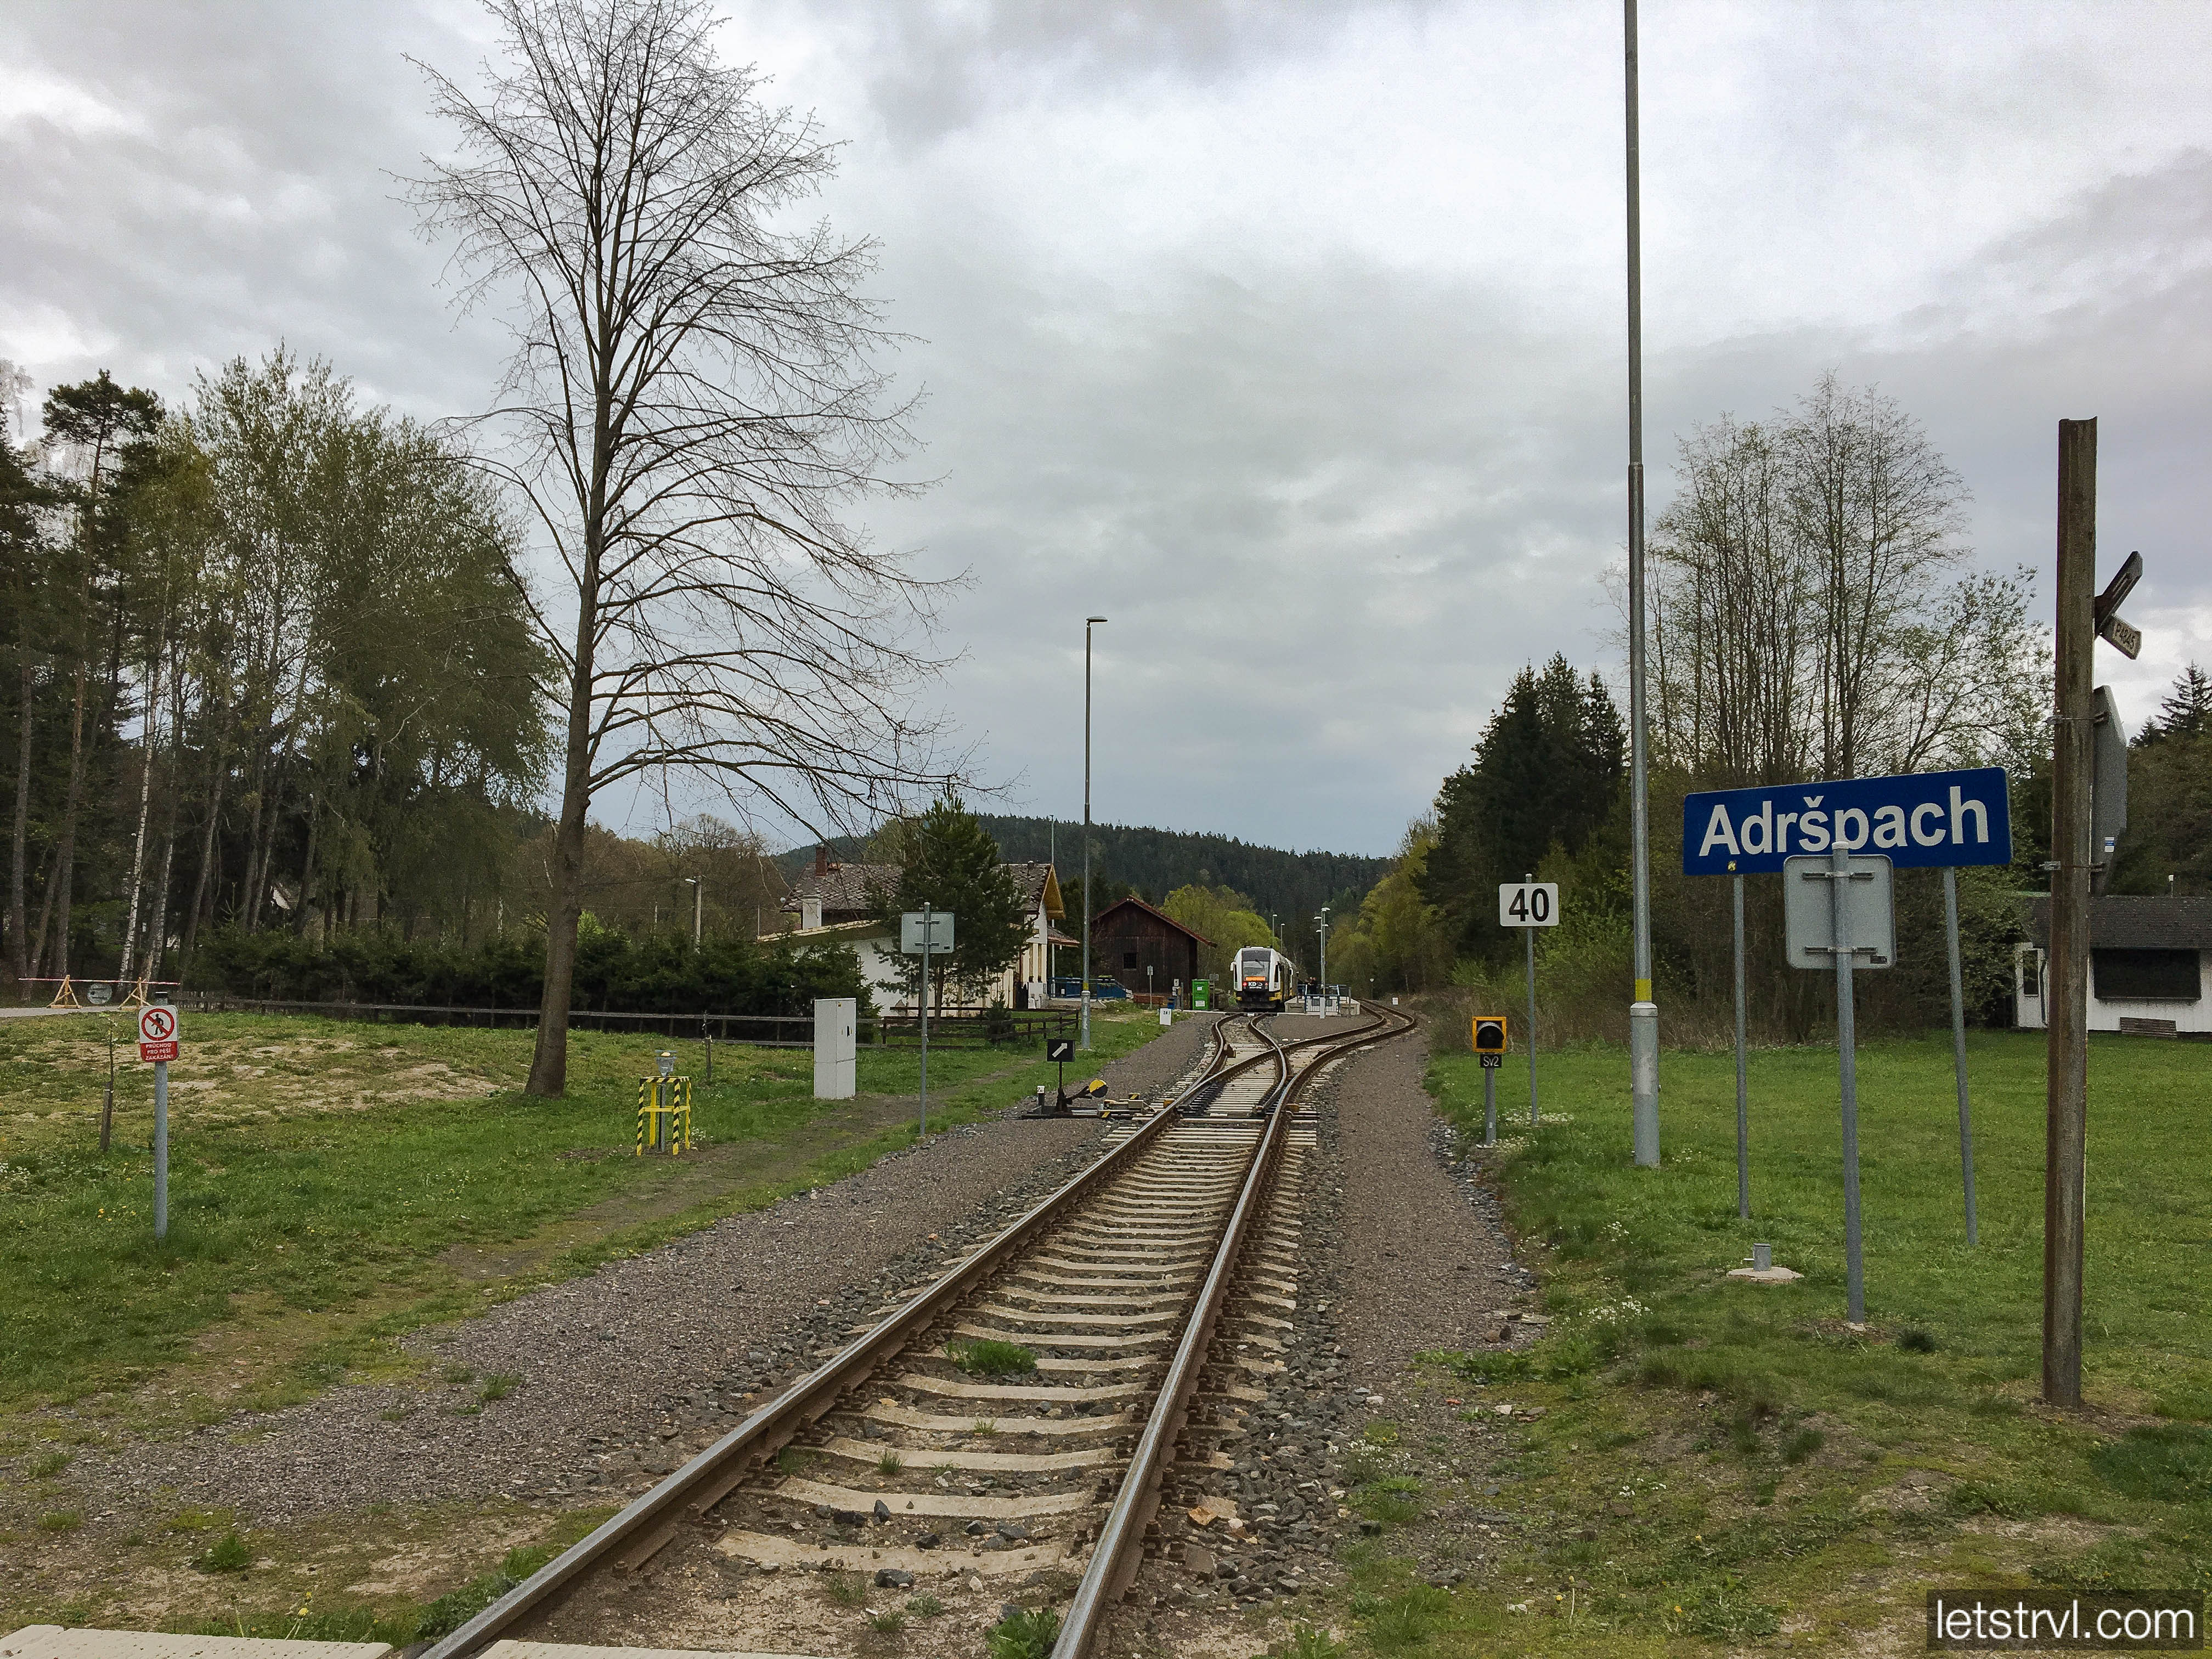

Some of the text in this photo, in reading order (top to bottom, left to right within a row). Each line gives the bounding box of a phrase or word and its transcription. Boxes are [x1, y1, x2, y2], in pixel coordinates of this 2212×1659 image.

[1699, 786, 1989, 856] Adršpach
[1509, 888, 1549, 922] 40
[1483, 1056, 1499, 1066] Sv2
